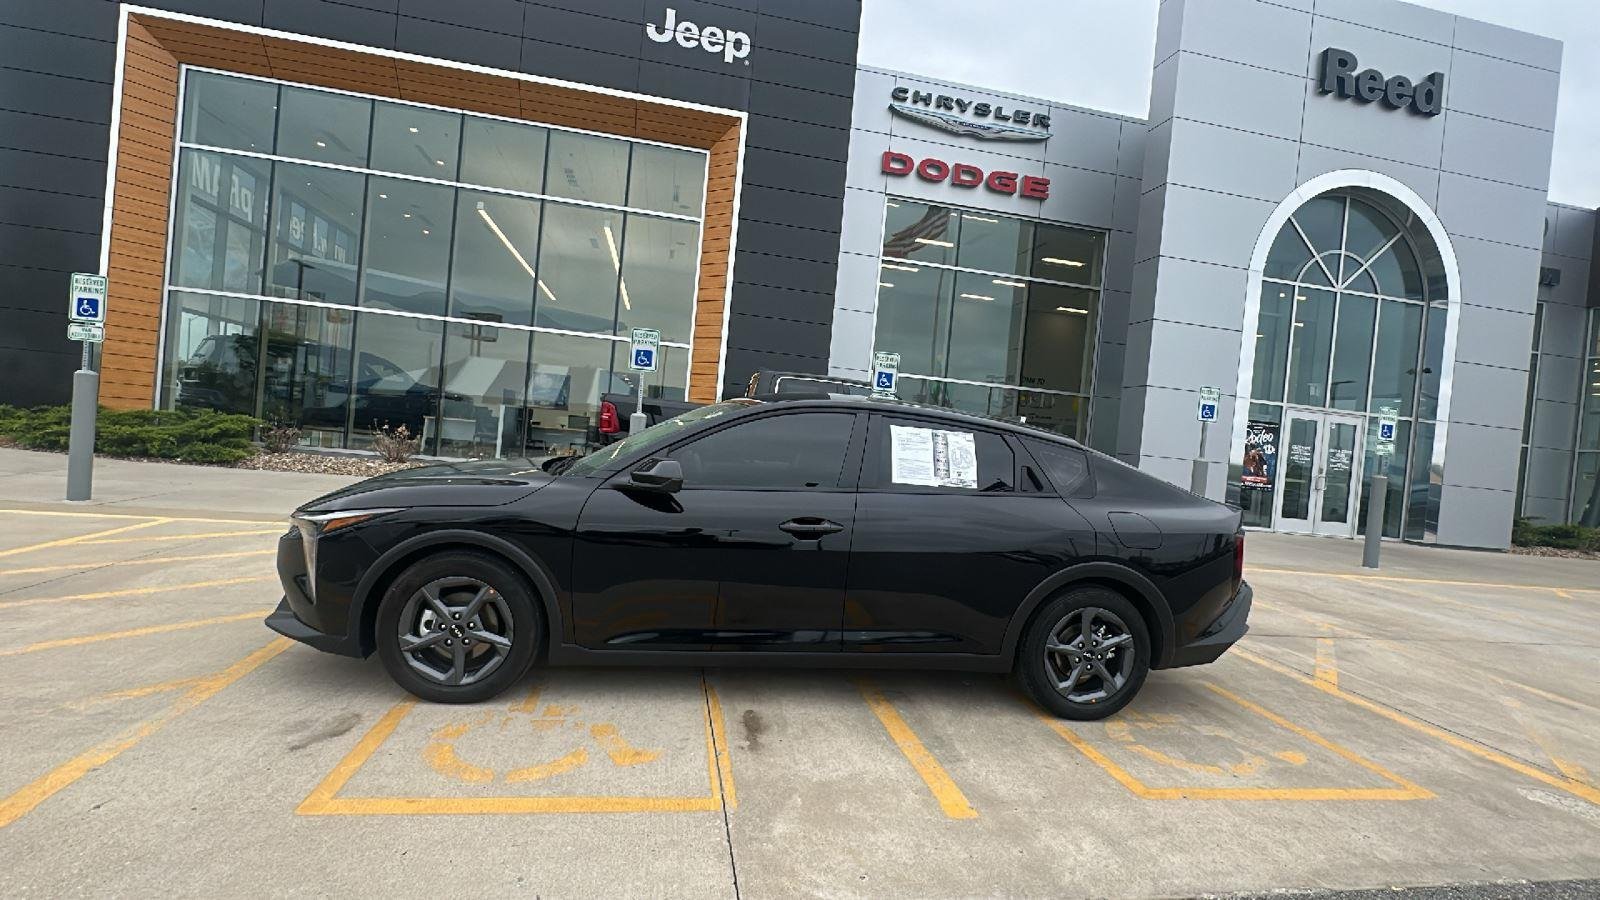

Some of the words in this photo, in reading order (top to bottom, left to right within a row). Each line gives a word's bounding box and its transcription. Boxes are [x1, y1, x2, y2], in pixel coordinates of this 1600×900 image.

[646, 7, 751, 64] Jeep
[1318, 47, 1445, 117] Reed
[891, 87, 1051, 128] CHRYSLER
[881, 151, 1051, 200] DODGE
[74, 277, 104, 287] RESERVED
[74, 286, 104, 294] PARKING
